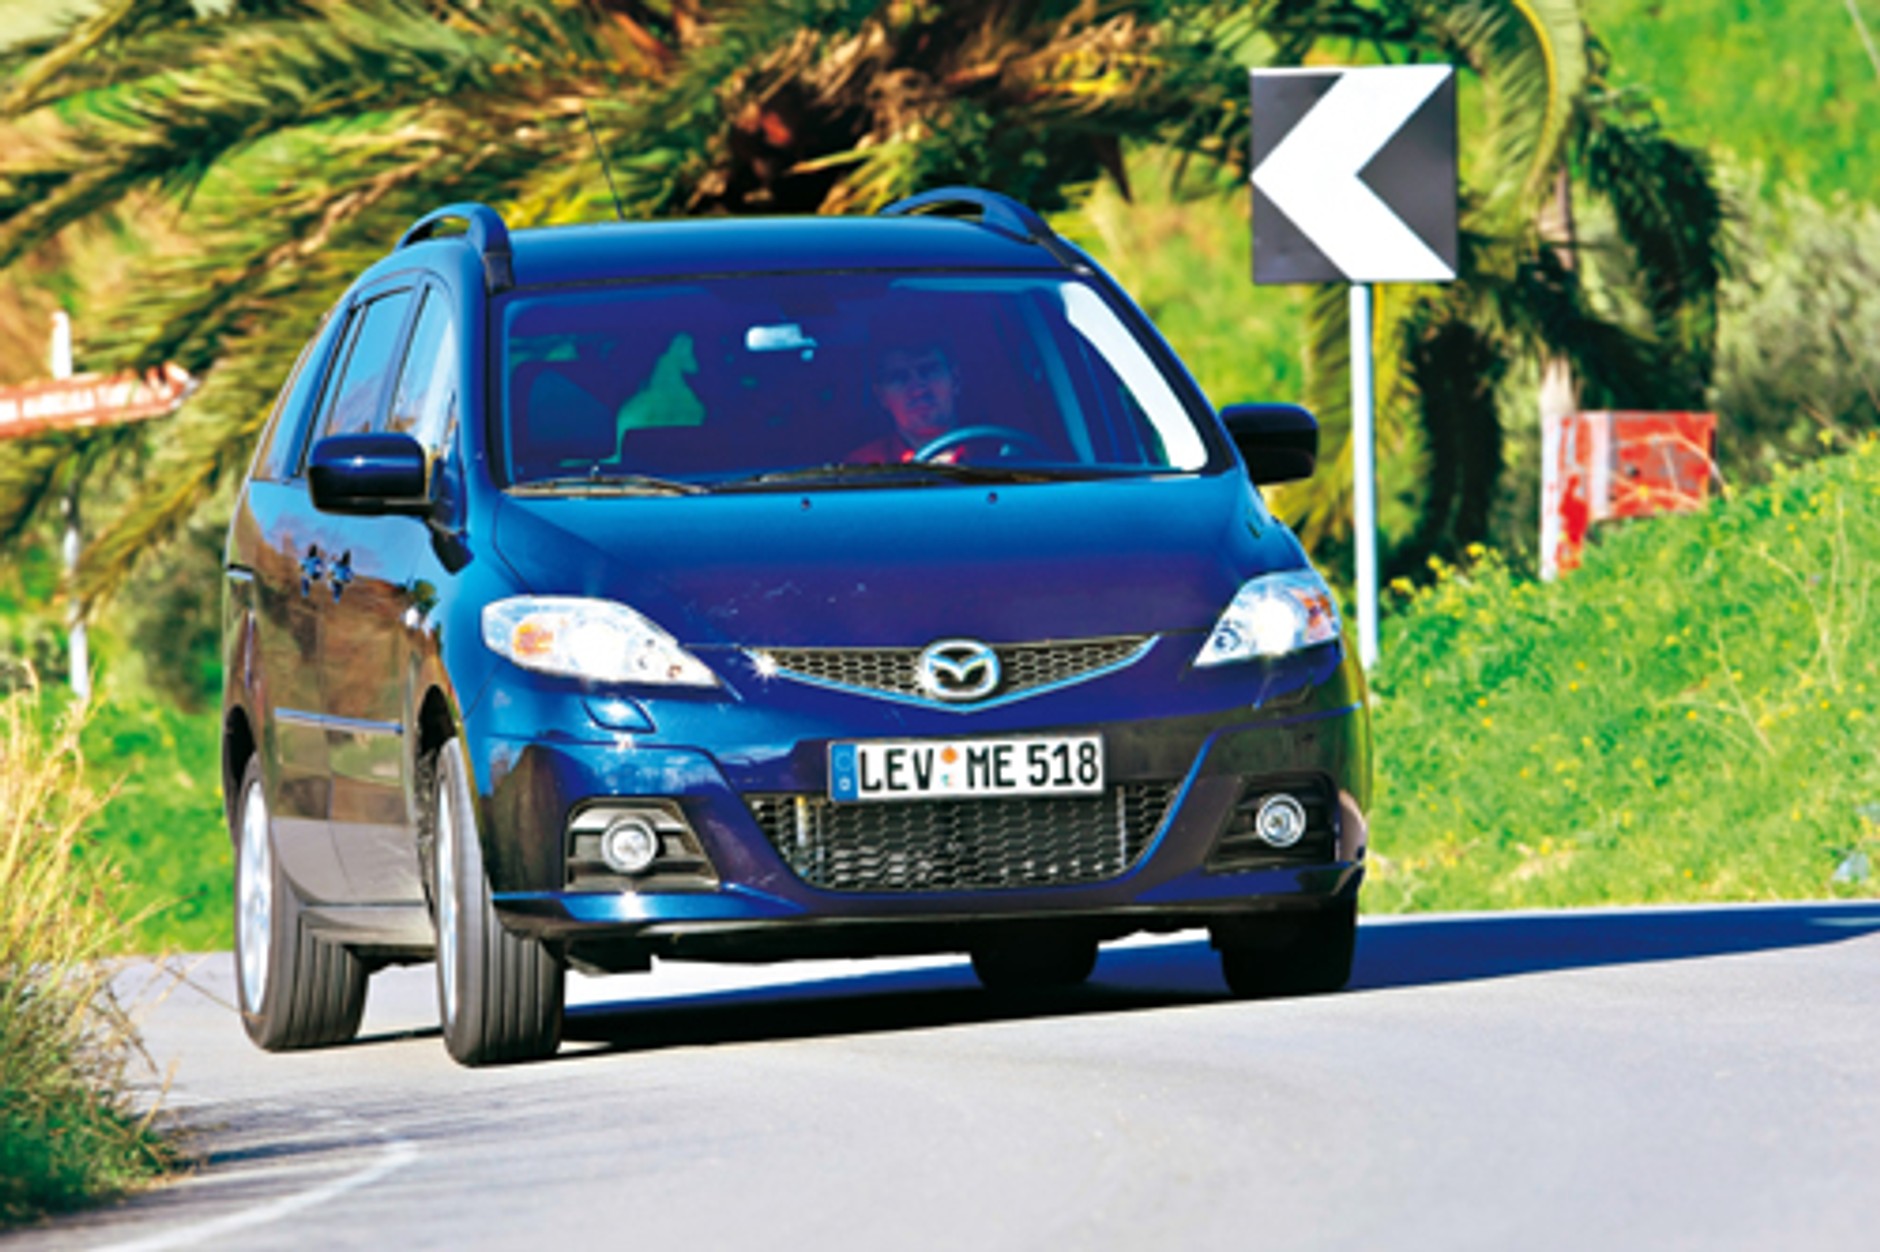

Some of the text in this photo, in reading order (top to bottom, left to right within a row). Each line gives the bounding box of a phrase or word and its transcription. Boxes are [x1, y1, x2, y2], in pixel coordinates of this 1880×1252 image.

[860, 741, 1099, 791] LEV ME 518
